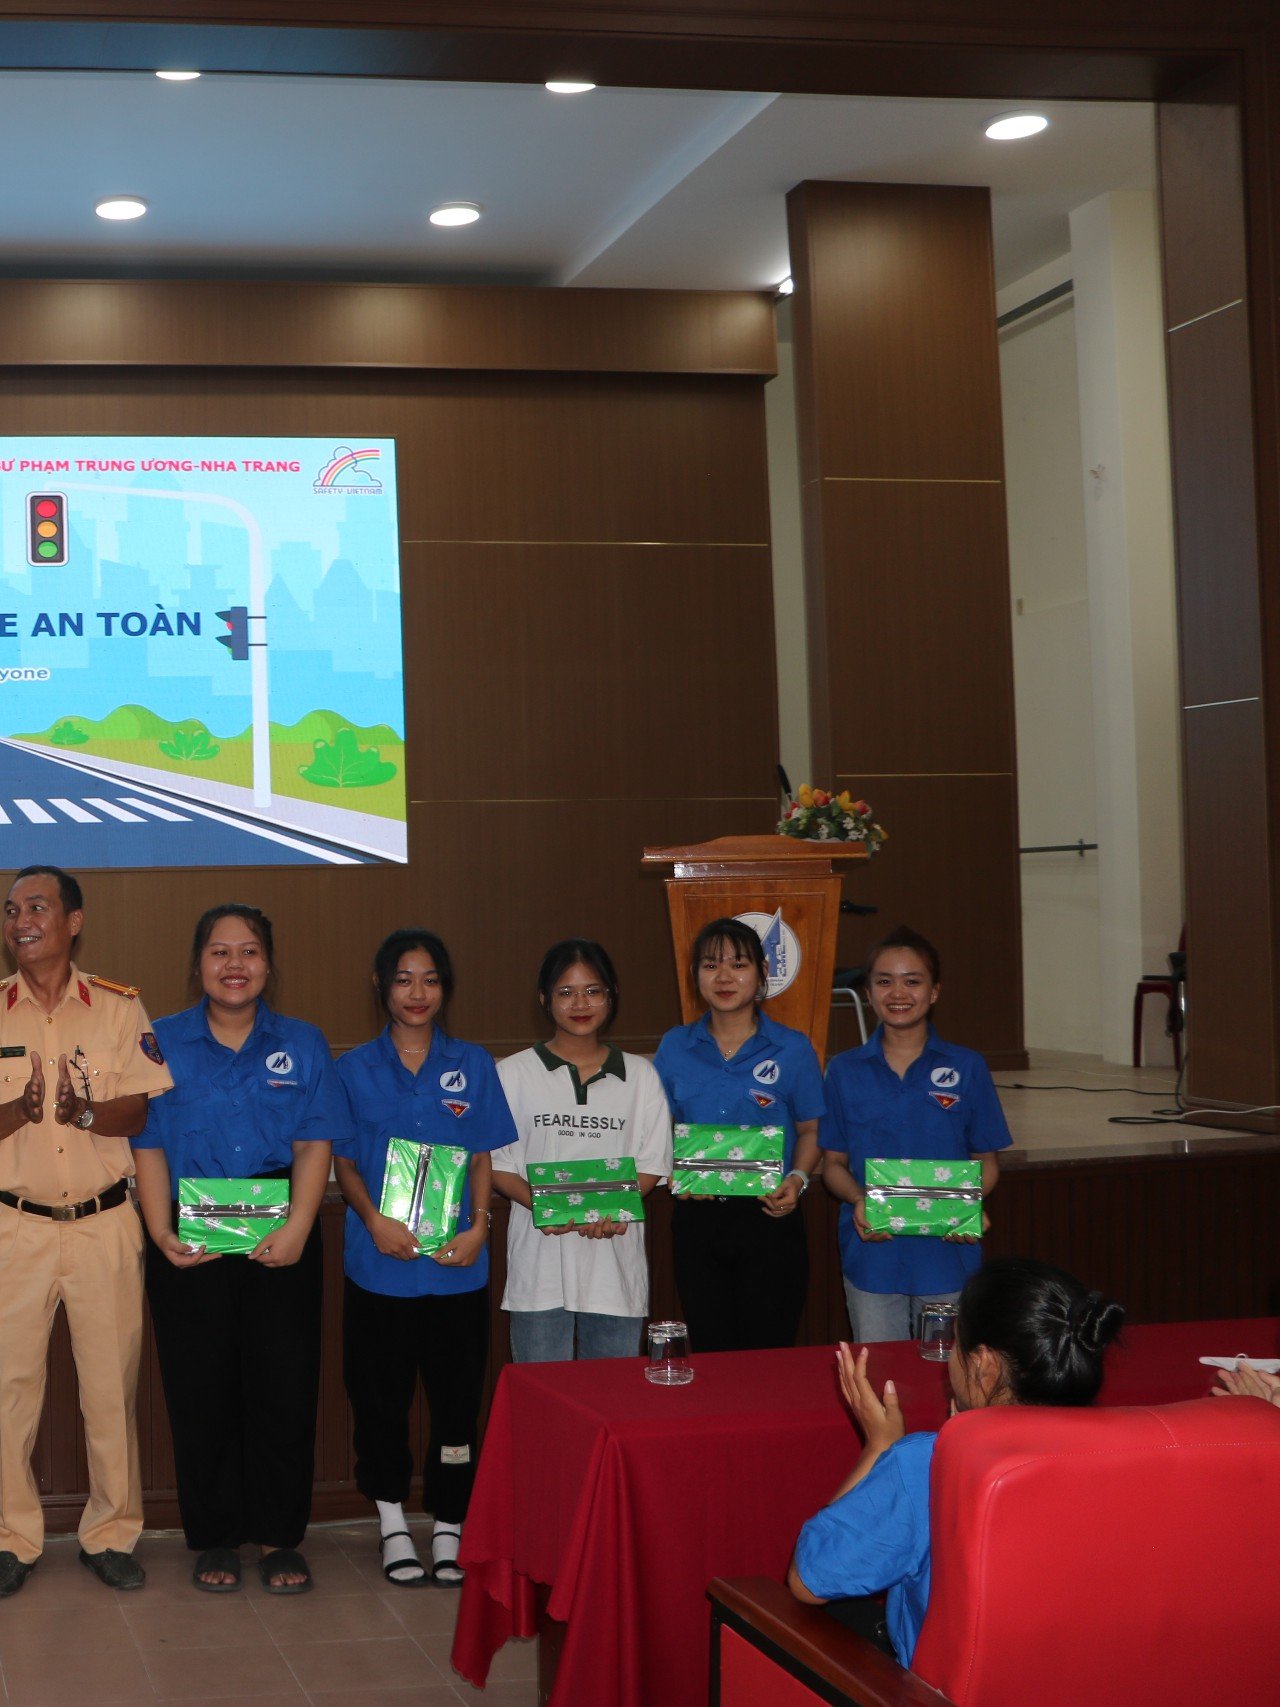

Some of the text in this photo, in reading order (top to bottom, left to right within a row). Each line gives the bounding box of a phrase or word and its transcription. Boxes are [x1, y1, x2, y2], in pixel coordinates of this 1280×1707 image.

[20, 459, 70, 475] PHẠM
[75, 460, 135, 472] TRUNG
[140, 457, 237, 472] ƯƠNG-NHA
[242, 460, 300, 473] TRANG
[30, 612, 84, 637] AN
[96, 603, 201, 637] TOÀN
[533, 1113, 626, 1131] FEARLESSLY
